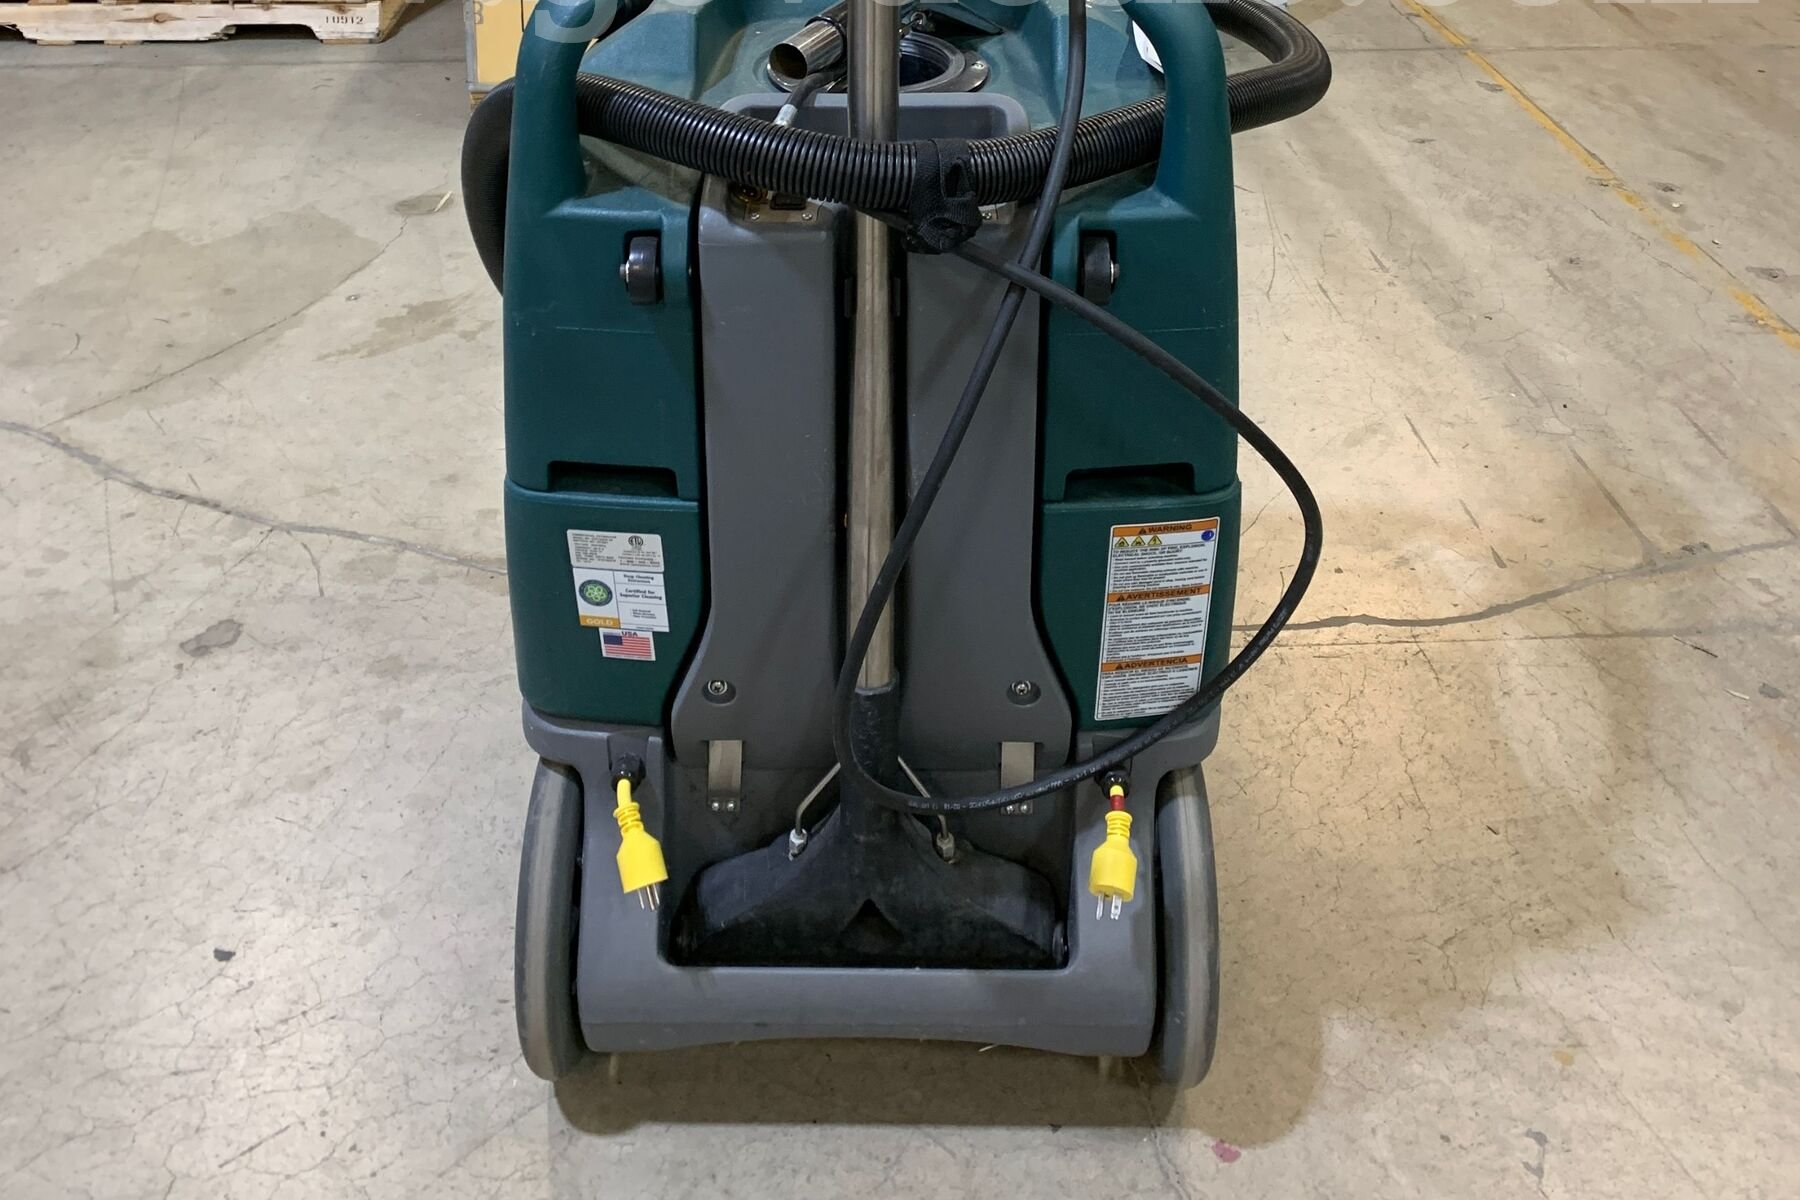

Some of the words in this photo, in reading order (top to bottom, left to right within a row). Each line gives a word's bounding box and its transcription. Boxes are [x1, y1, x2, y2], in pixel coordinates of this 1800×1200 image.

[1148, 524, 1193, 534] WARNING
[1126, 587, 1202, 600] AVERTISSEMENT
[586, 617, 613, 626] GOLD
[621, 630, 639, 638] USA
[1122, 657, 1188, 669] ADVERTENCIA
